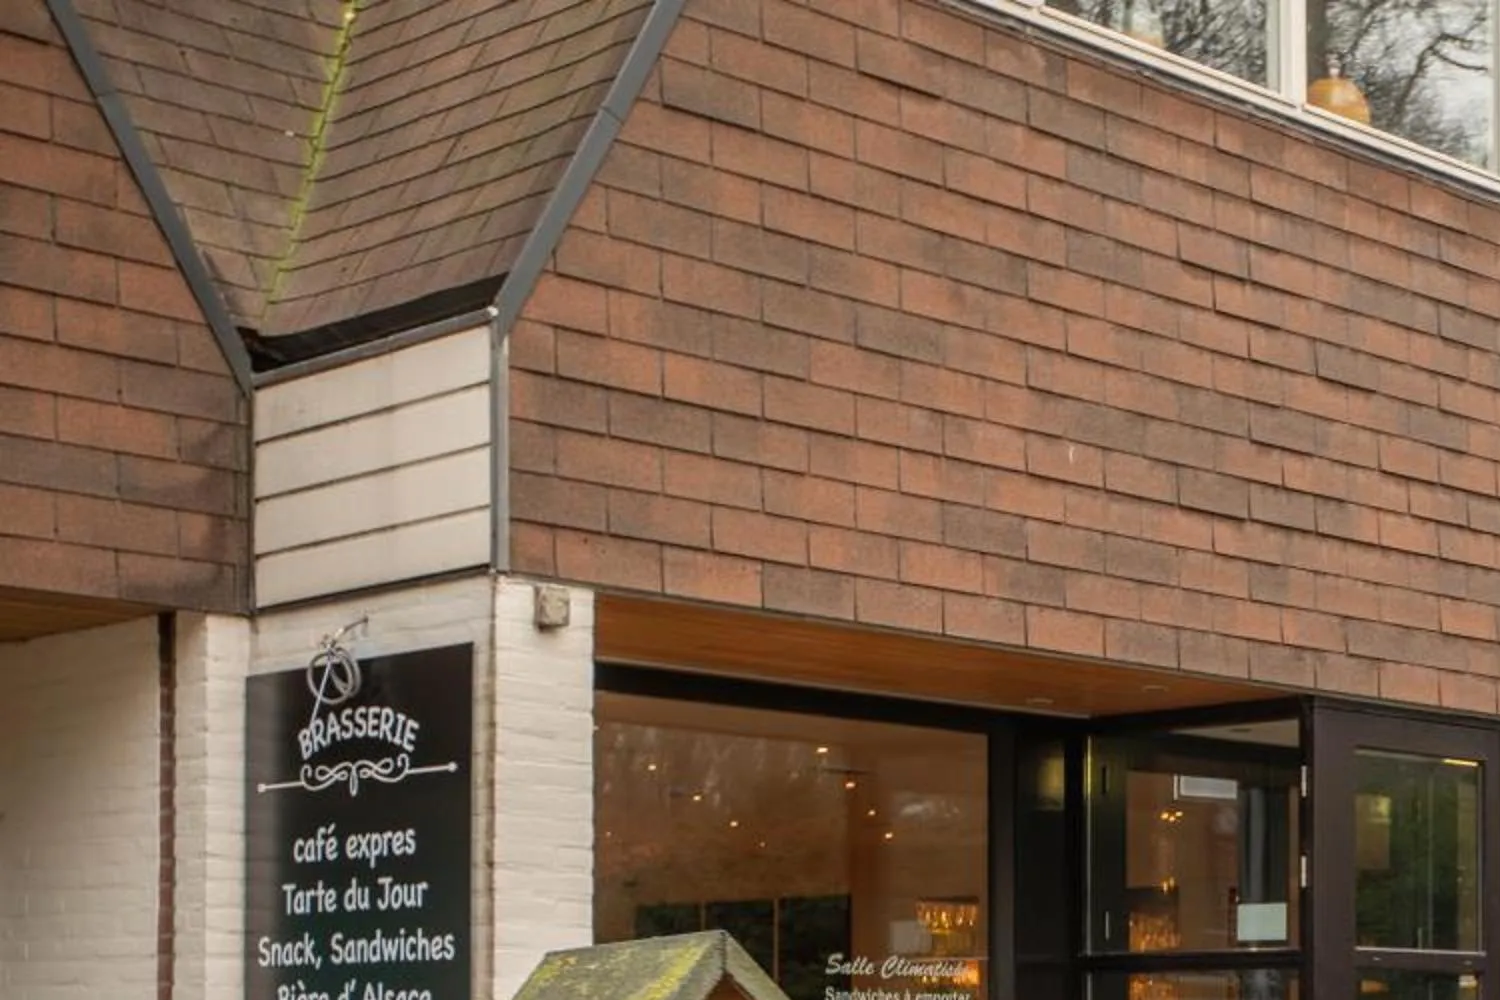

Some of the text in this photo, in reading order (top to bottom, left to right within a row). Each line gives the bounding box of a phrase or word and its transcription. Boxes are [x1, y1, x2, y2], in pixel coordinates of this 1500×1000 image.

[297, 706, 420, 760] BRASSERIE
[293, 823, 416, 869] café expres
[282, 876, 429, 915] Tarte du Jour
[258, 928, 455, 970] Snack, Sandwiches
[824, 952, 968, 979] Salle Climatisé
